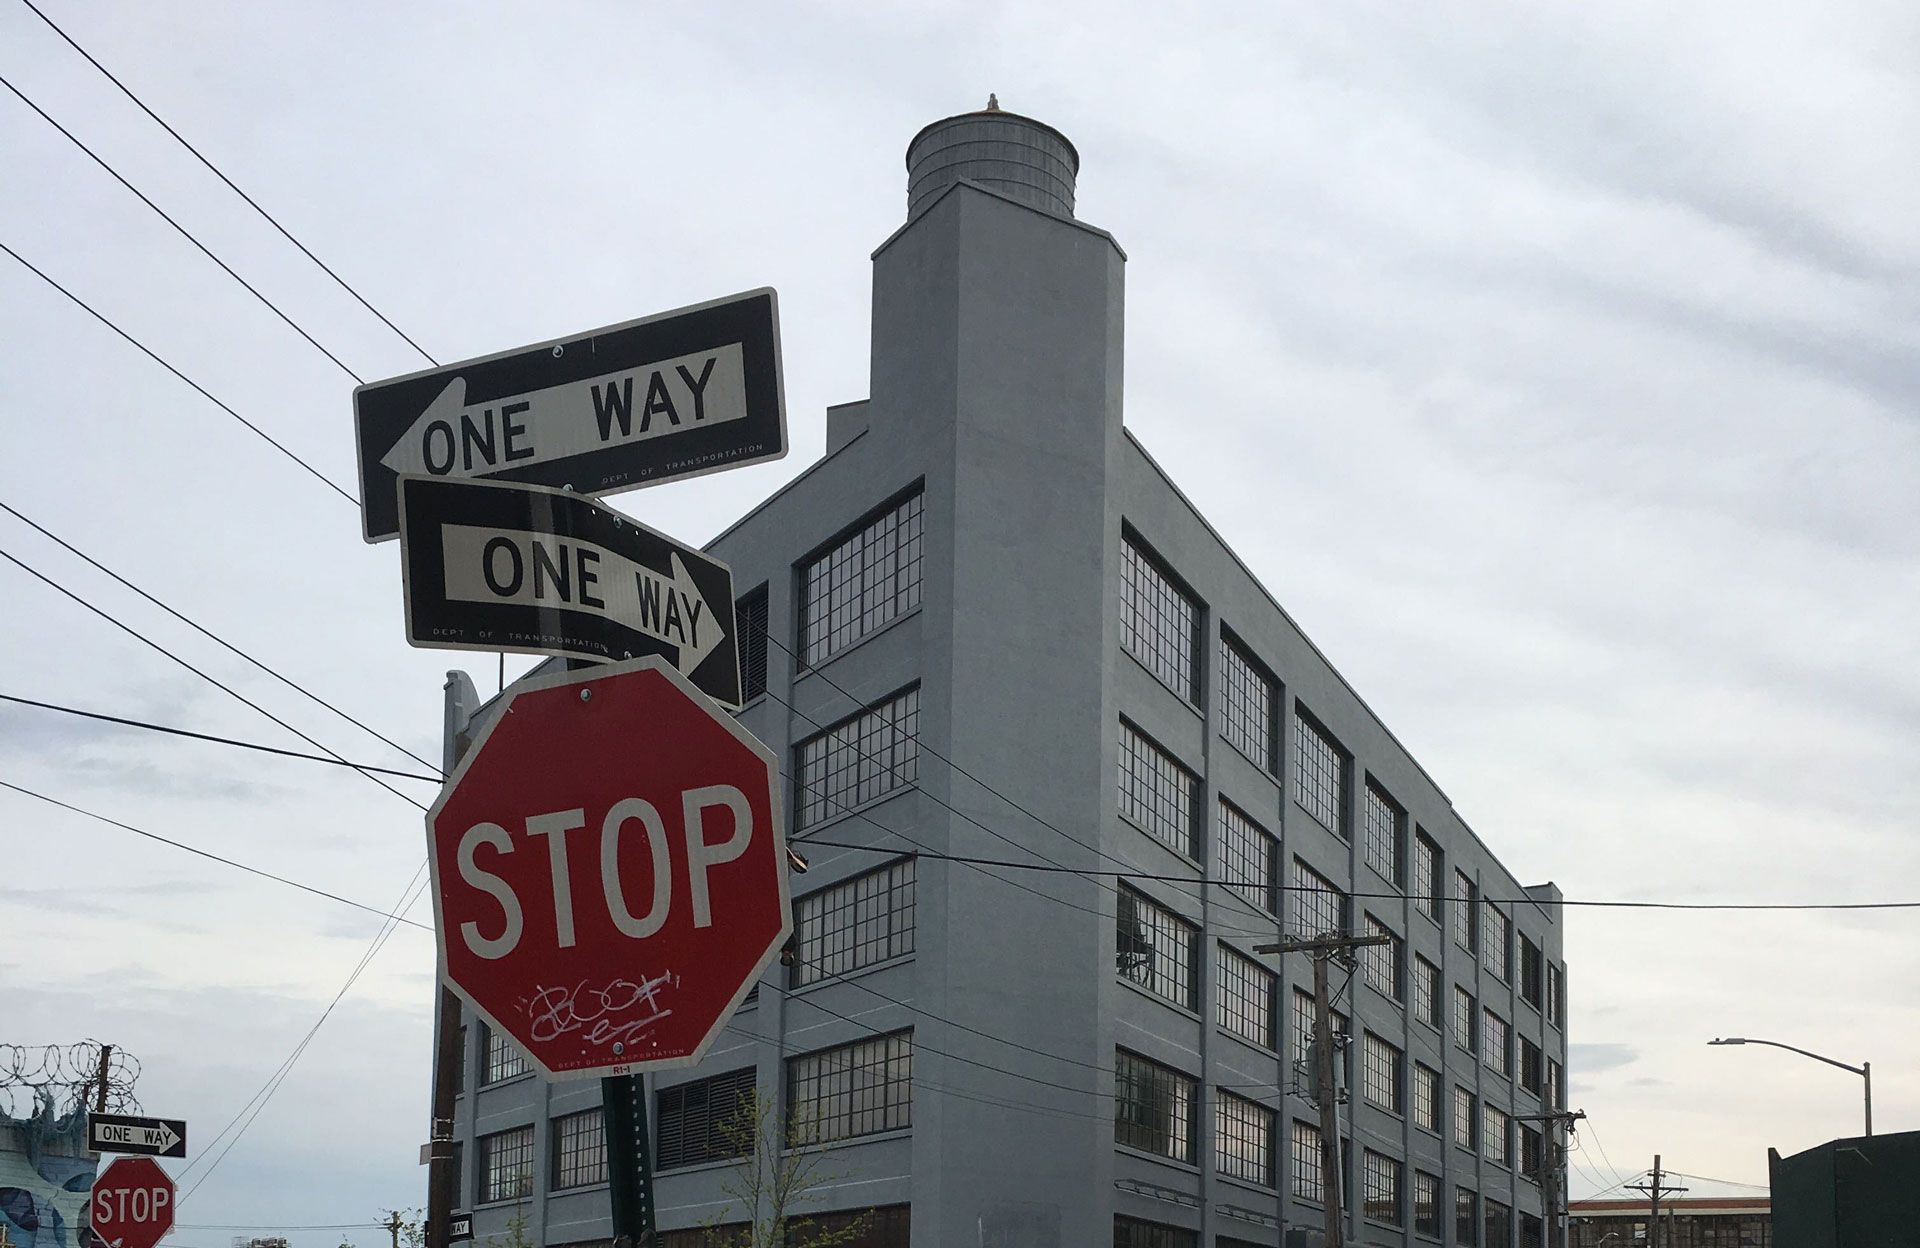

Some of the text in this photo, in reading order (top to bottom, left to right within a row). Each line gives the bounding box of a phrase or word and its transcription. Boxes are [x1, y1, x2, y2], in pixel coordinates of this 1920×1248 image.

[422, 357, 717, 476] ONE WAY
[602, 444, 763, 484] DEPT OF TRANSPORTATION
[482, 537, 702, 648] ONE WAY
[433, 628, 608, 651] DEPT OF TRANSPORTATION
[457, 784, 753, 960] STOP
[558, 1061, 580, 1069] DEPT
[602, 1049, 685, 1064] TRANSPORTATION
[613, 1065, 631, 1075] R1-1
[103, 1126, 172, 1146] ONE WAY
[96, 1187, 169, 1224] STOP
